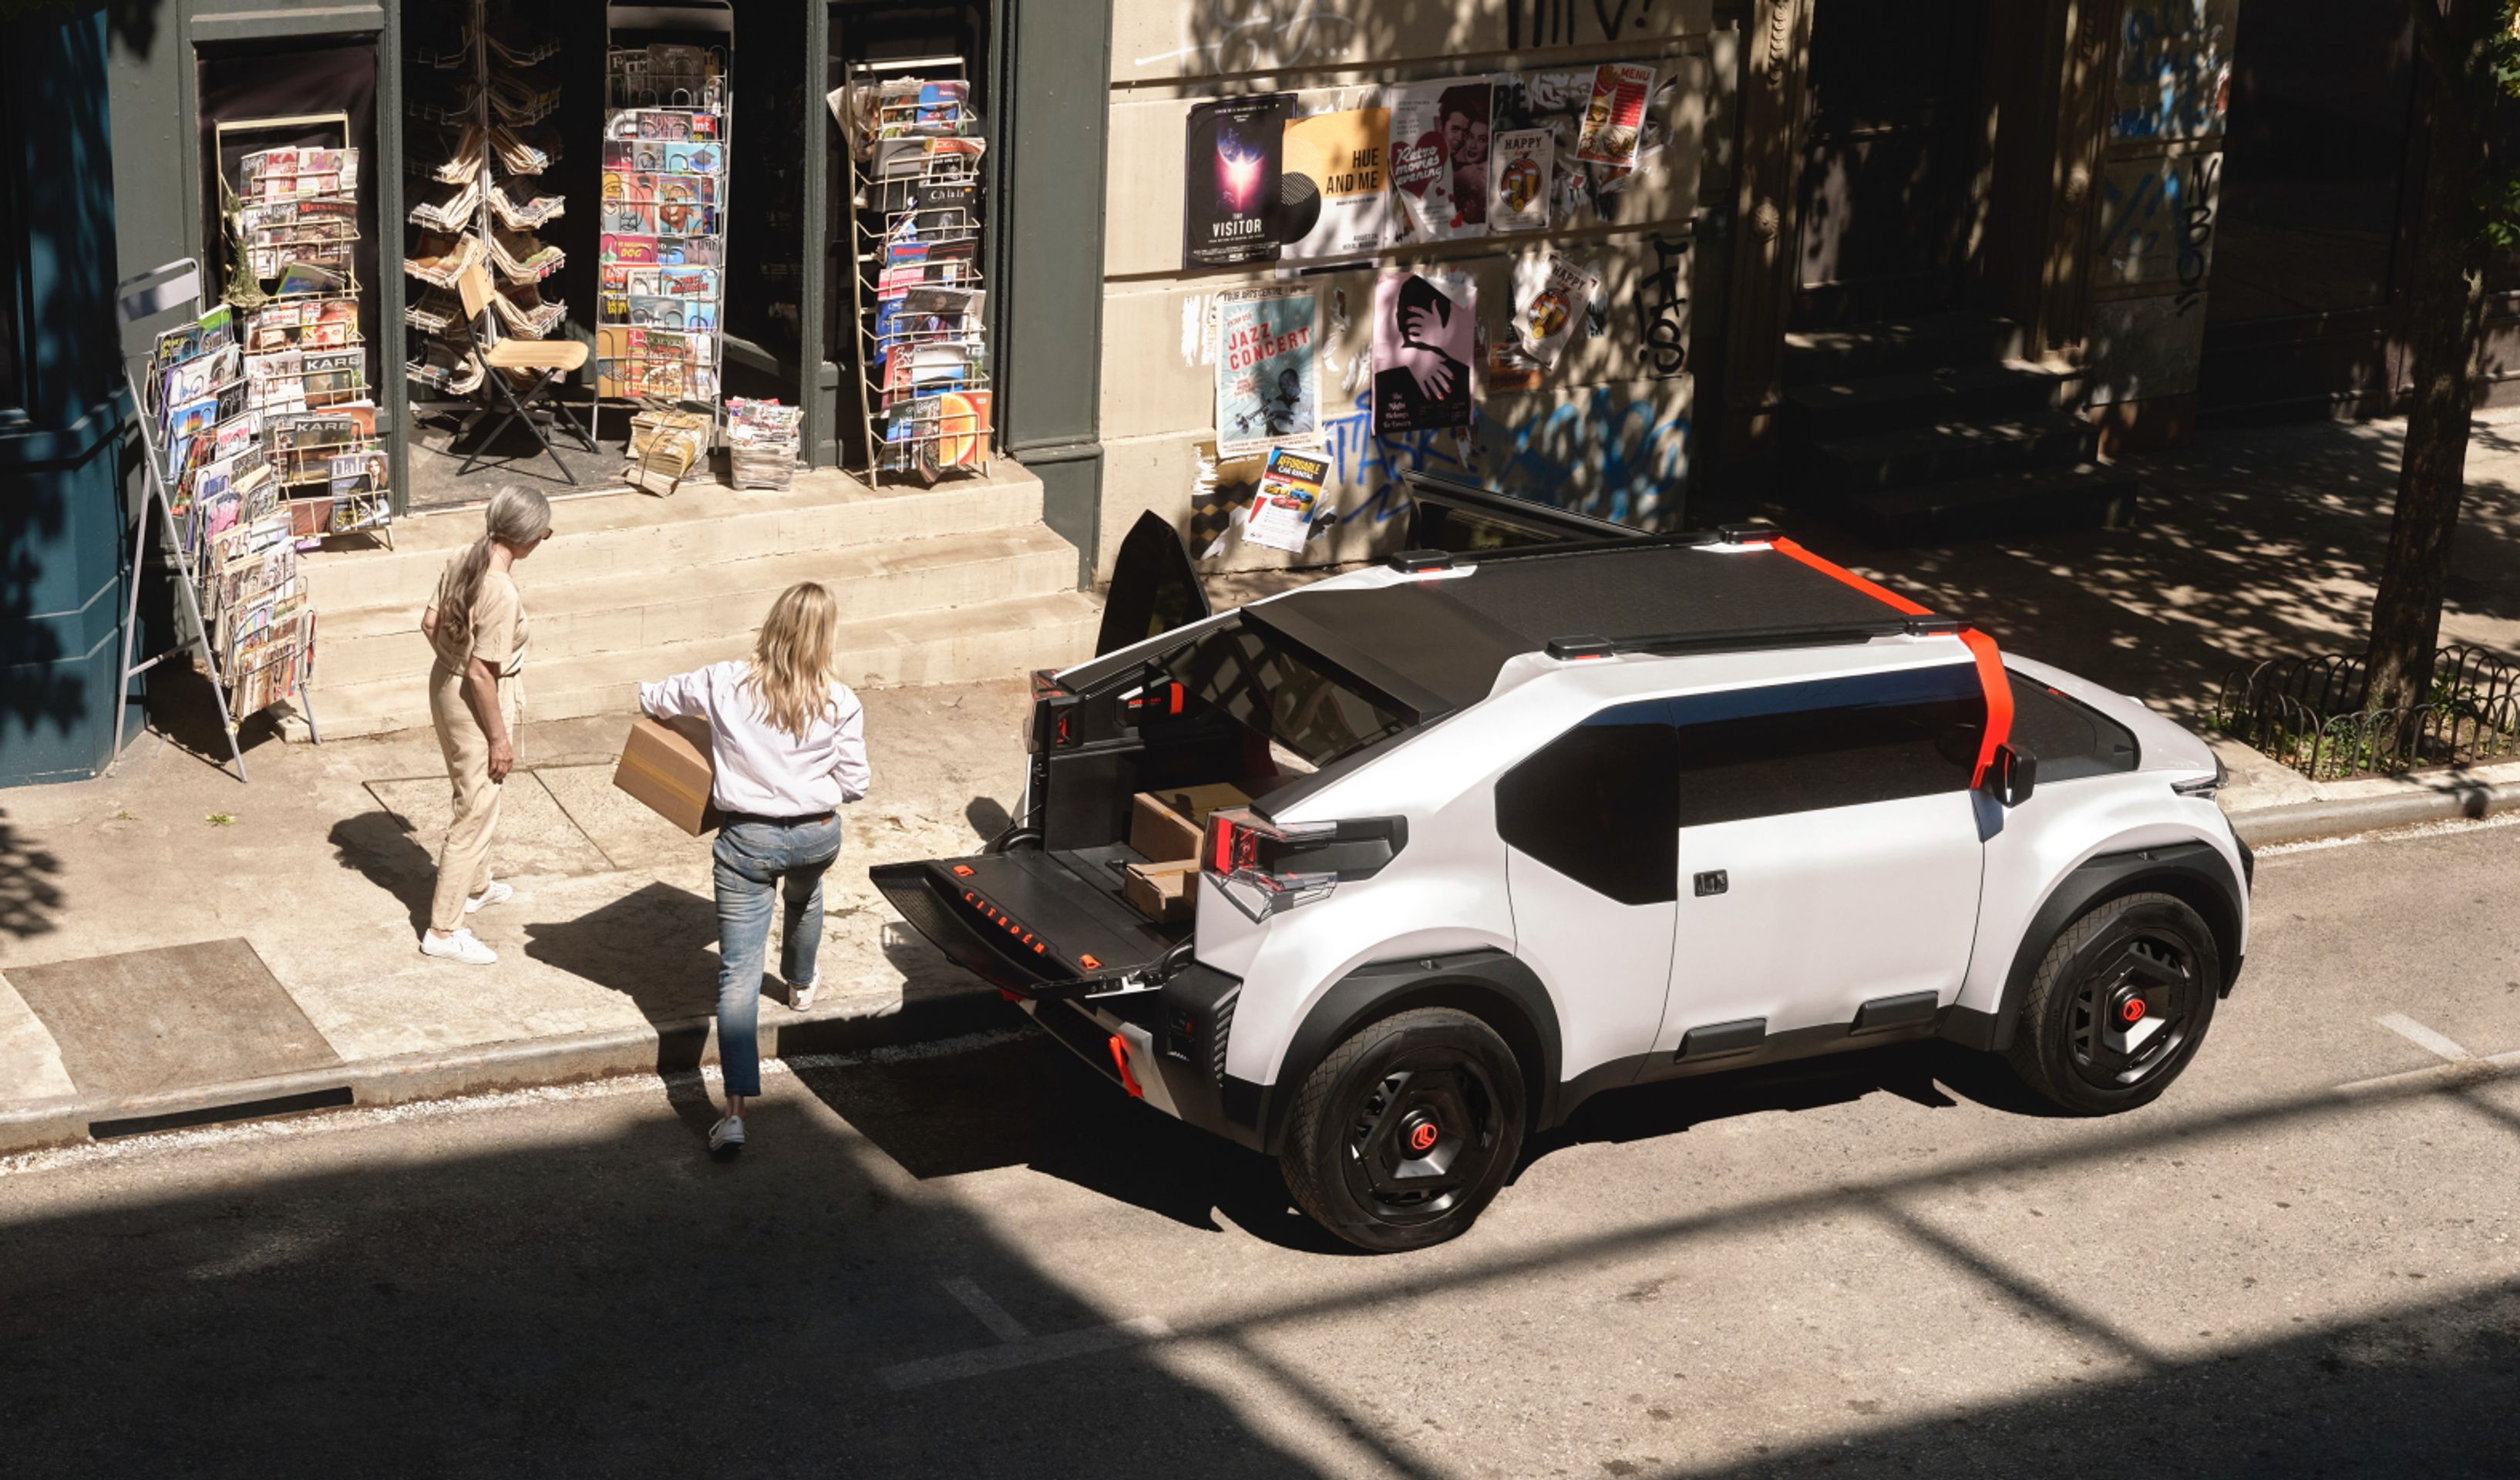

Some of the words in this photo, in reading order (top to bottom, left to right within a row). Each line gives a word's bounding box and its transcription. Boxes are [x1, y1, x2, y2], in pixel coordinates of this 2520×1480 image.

[1620, 68, 1650, 81] MENU
[1505, 136, 1542, 150] HAPPY
[1352, 147, 1379, 169] HUE
[1326, 174, 1354, 194] AND
[1358, 170, 1379, 190] ME
[1213, 218, 1262, 237] VISITOR
[1552, 264, 1586, 291] HAPPY
[1228, 322, 1271, 351] JAZZ
[1229, 327, 1310, 370] CONCERT
